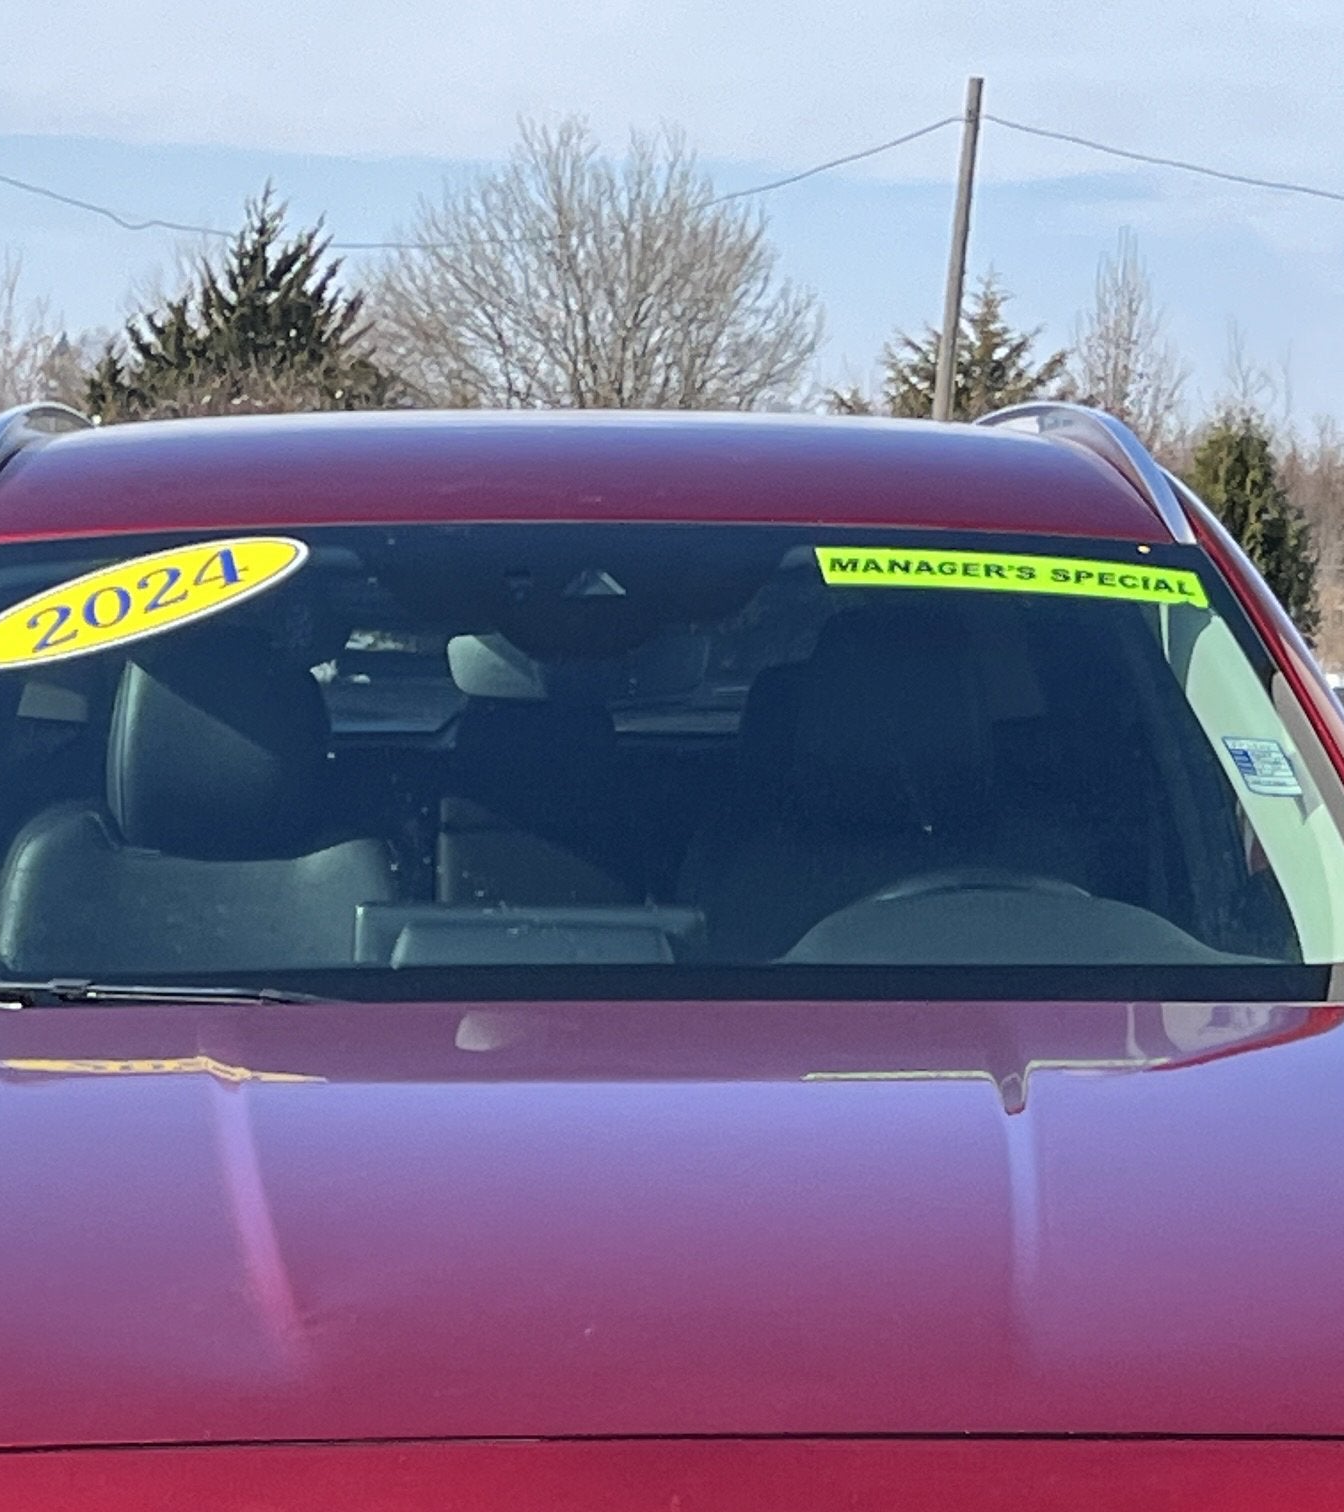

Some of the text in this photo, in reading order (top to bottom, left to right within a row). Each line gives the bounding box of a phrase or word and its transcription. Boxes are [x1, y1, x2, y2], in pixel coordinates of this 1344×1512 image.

[26, 548, 249, 654] 2024
[828, 557, 1197, 597] MANAGER'S SPECIAL
